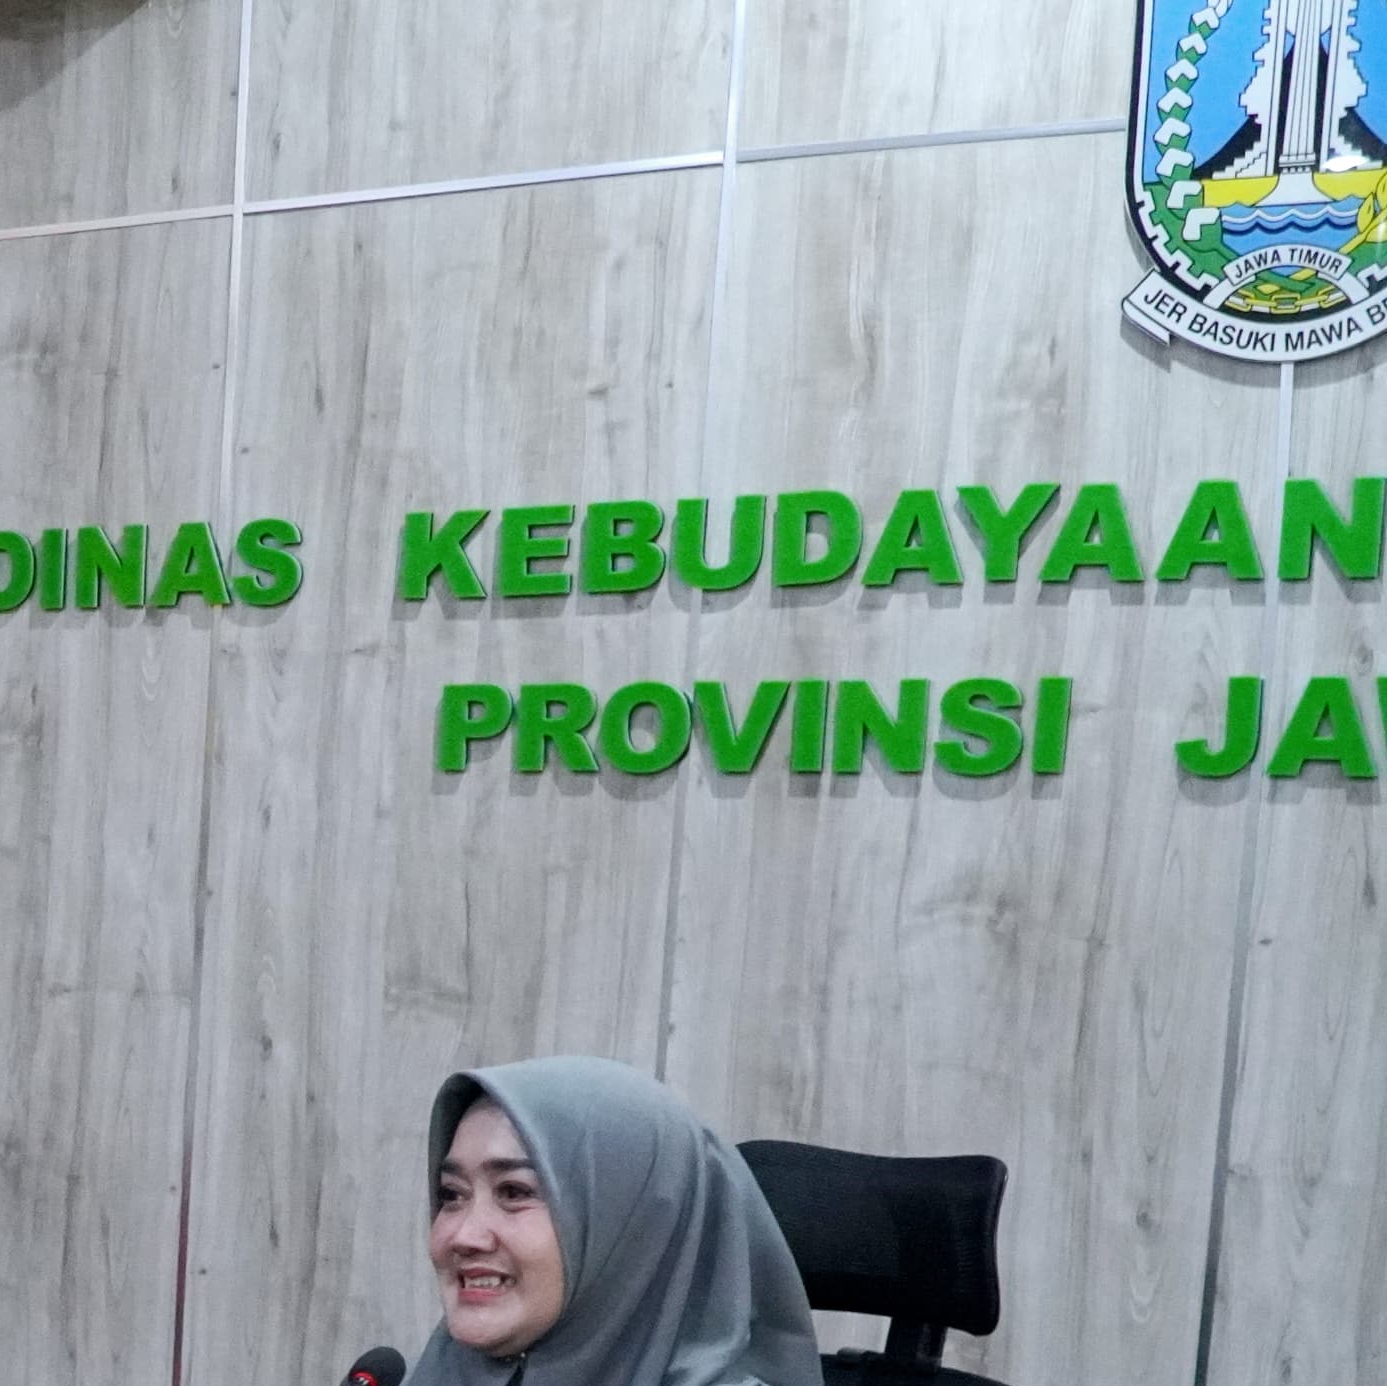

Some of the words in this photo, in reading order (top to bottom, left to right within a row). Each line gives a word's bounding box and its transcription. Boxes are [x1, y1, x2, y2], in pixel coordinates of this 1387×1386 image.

[1235, 249, 1282, 279] JAWA
[1288, 247, 1344, 274] TIMUR
[1143, 288, 1188, 322] JER
[1187, 315, 1276, 352] BASUKI
[1284, 316, 1363, 353] MAWA
[403, 477, 1387, 601] KEBUDAYAAN
[439, 677, 1071, 778] PROVINSI
[1175, 677, 1387, 779] JA
